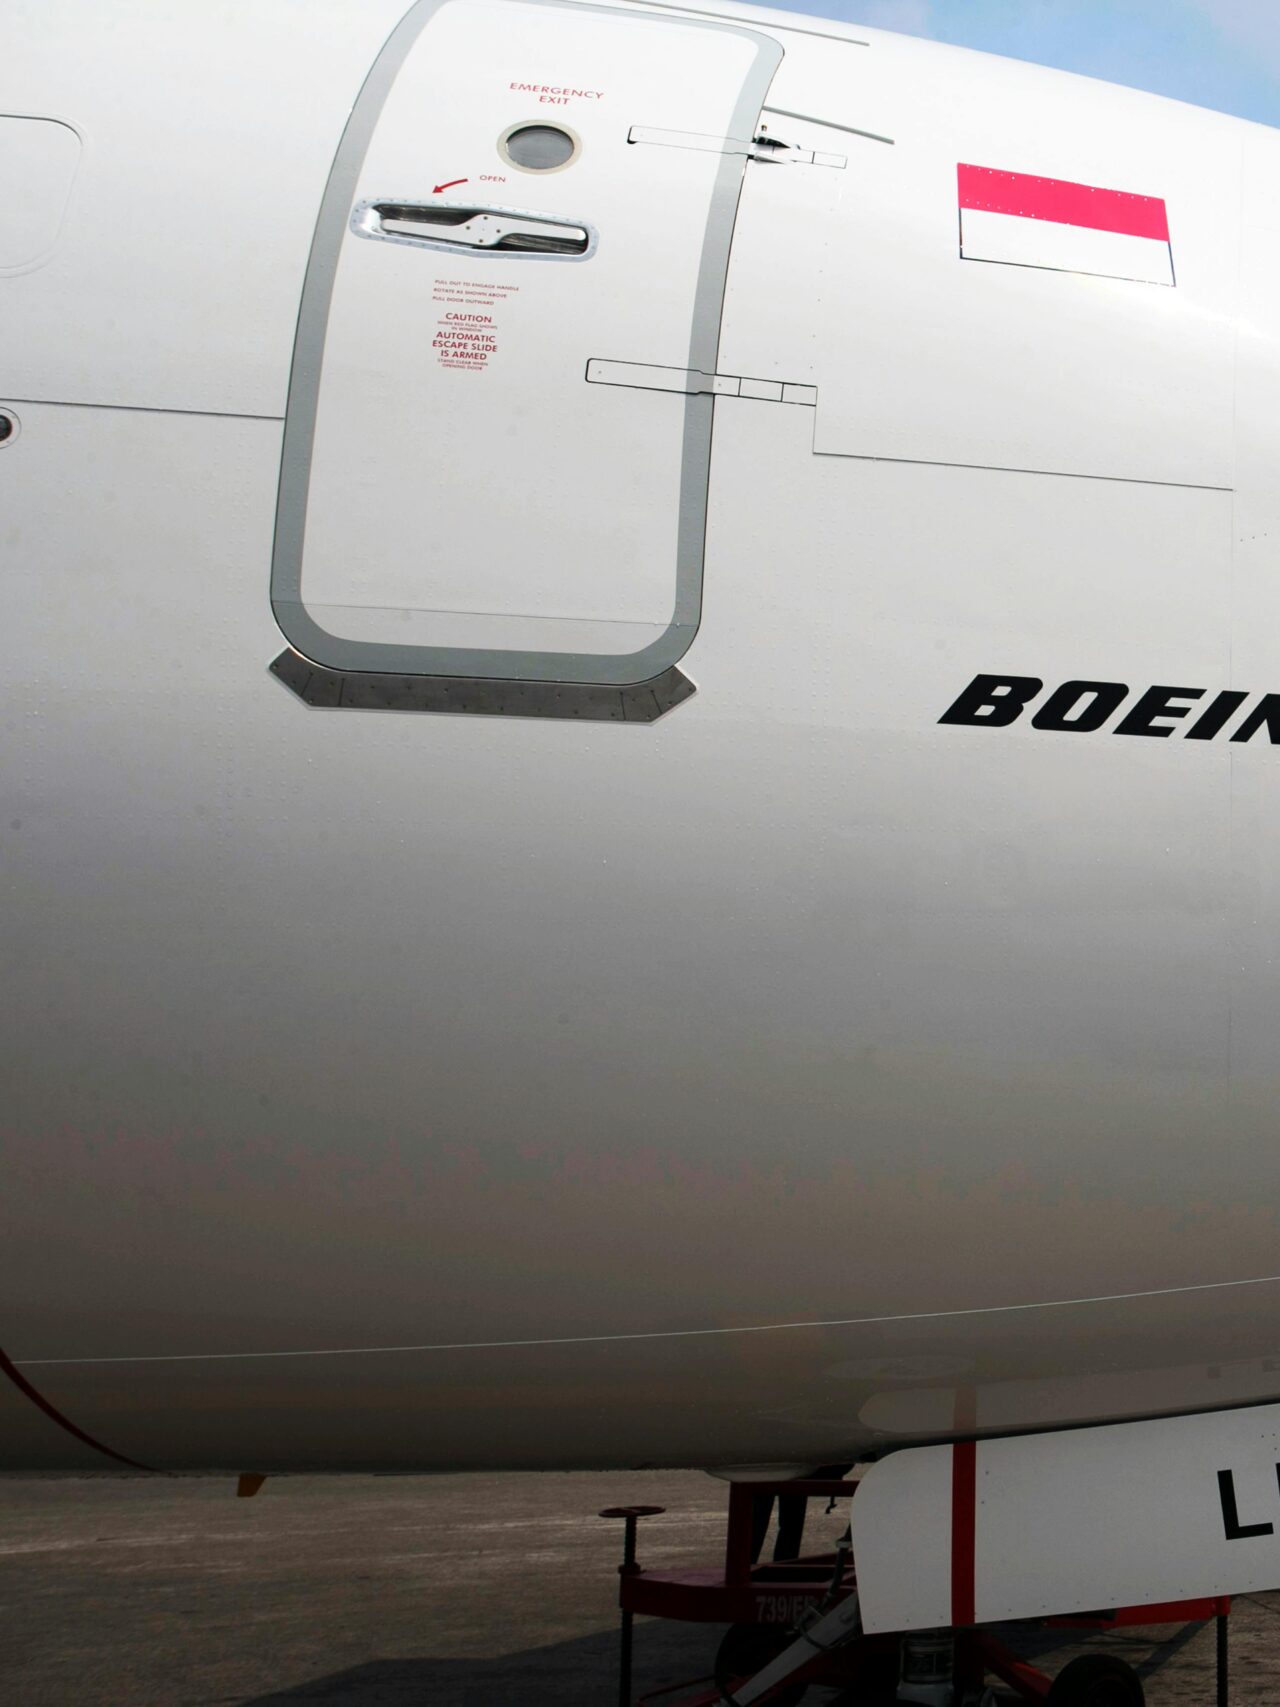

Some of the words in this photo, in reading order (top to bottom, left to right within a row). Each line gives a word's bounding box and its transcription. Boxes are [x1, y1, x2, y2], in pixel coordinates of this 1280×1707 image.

[509, 82, 605, 99] EMERGENCY
[539, 95, 571, 105] EXIT
[479, 174, 506, 182] OPEN
[445, 312, 492, 323] CAUTION
[436, 331, 496, 343] AUTOMATIC
[432, 339, 469, 349] ESCAPE
[471, 343, 498, 352] SLIDE
[440, 349, 449, 357] IS
[452, 351, 487, 360] ARMED
